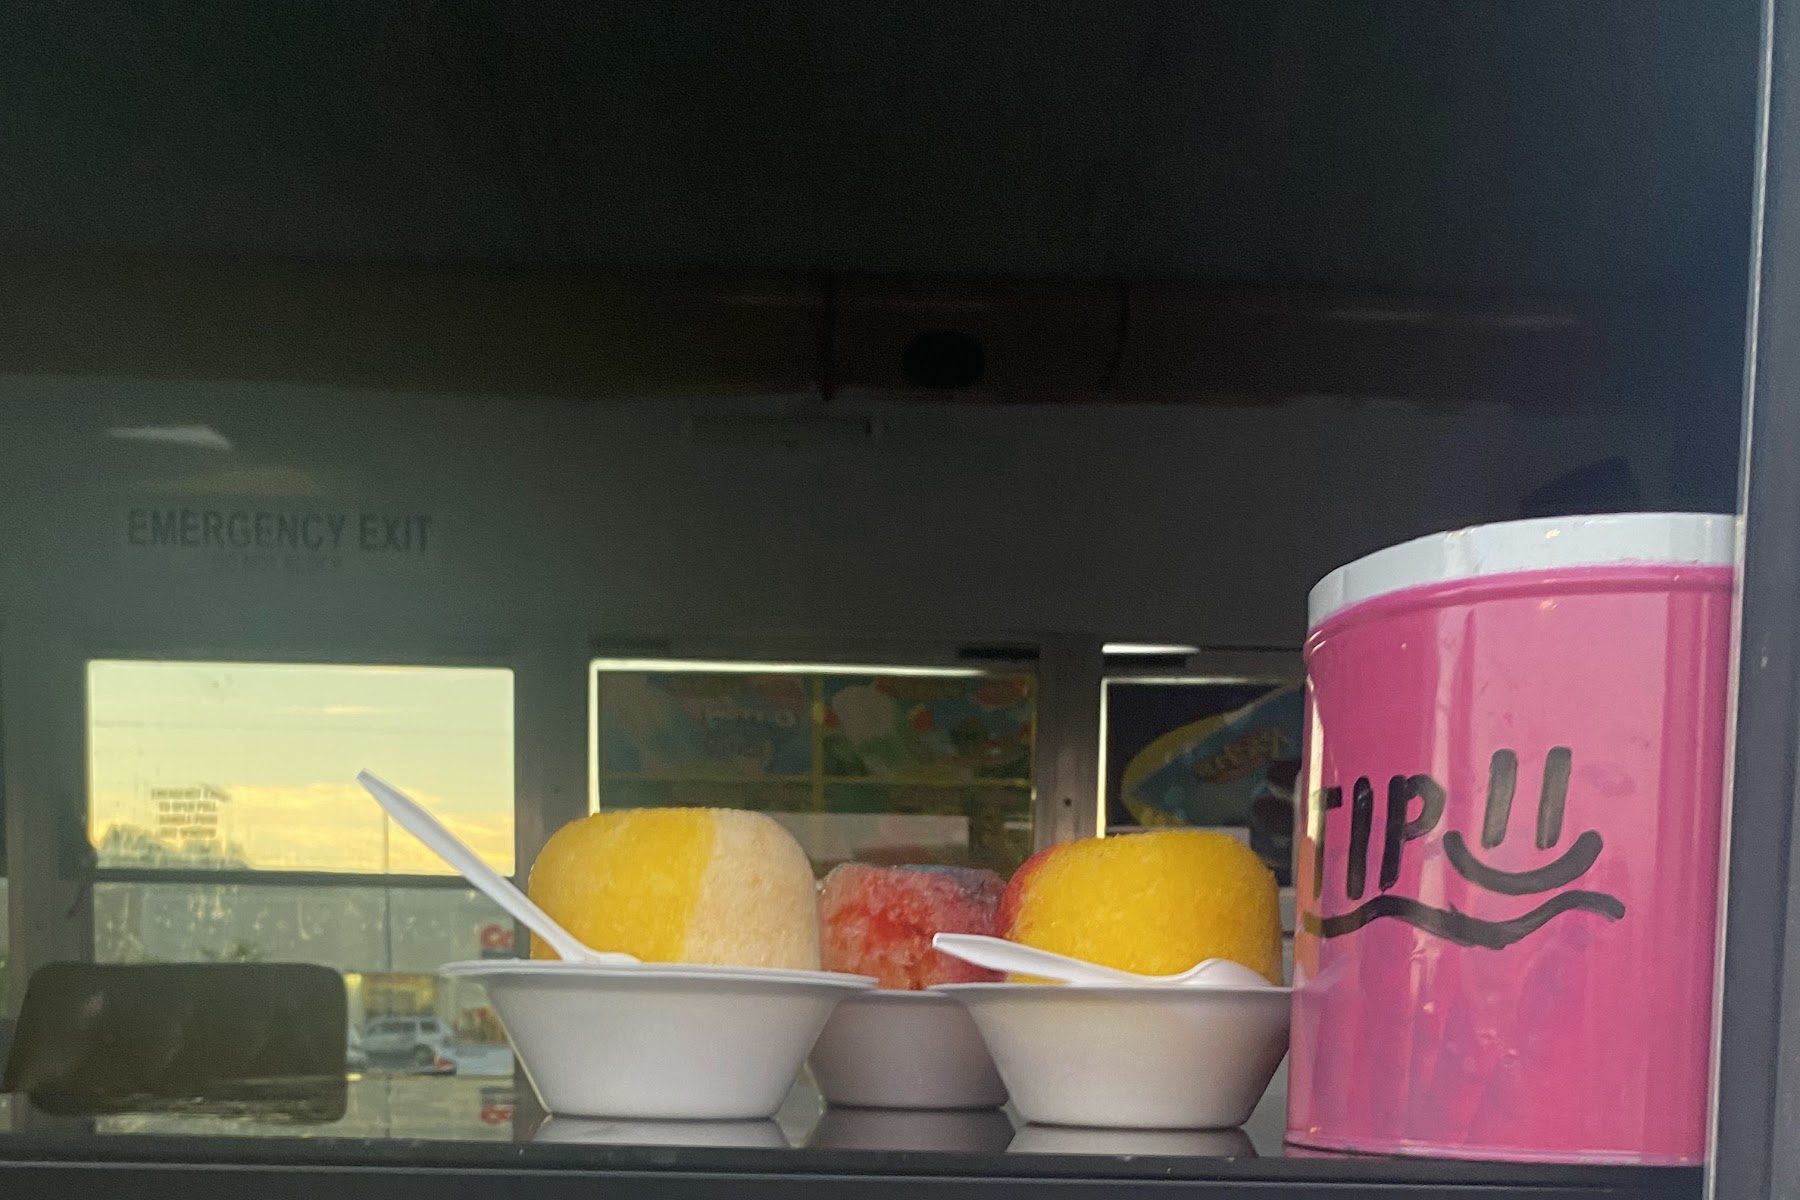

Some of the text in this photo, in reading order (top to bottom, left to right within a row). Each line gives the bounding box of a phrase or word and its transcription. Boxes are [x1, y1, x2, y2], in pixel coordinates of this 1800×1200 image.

[127, 508, 433, 553] EMERGENCY EXIT
[1310, 774, 1447, 900] TIP
